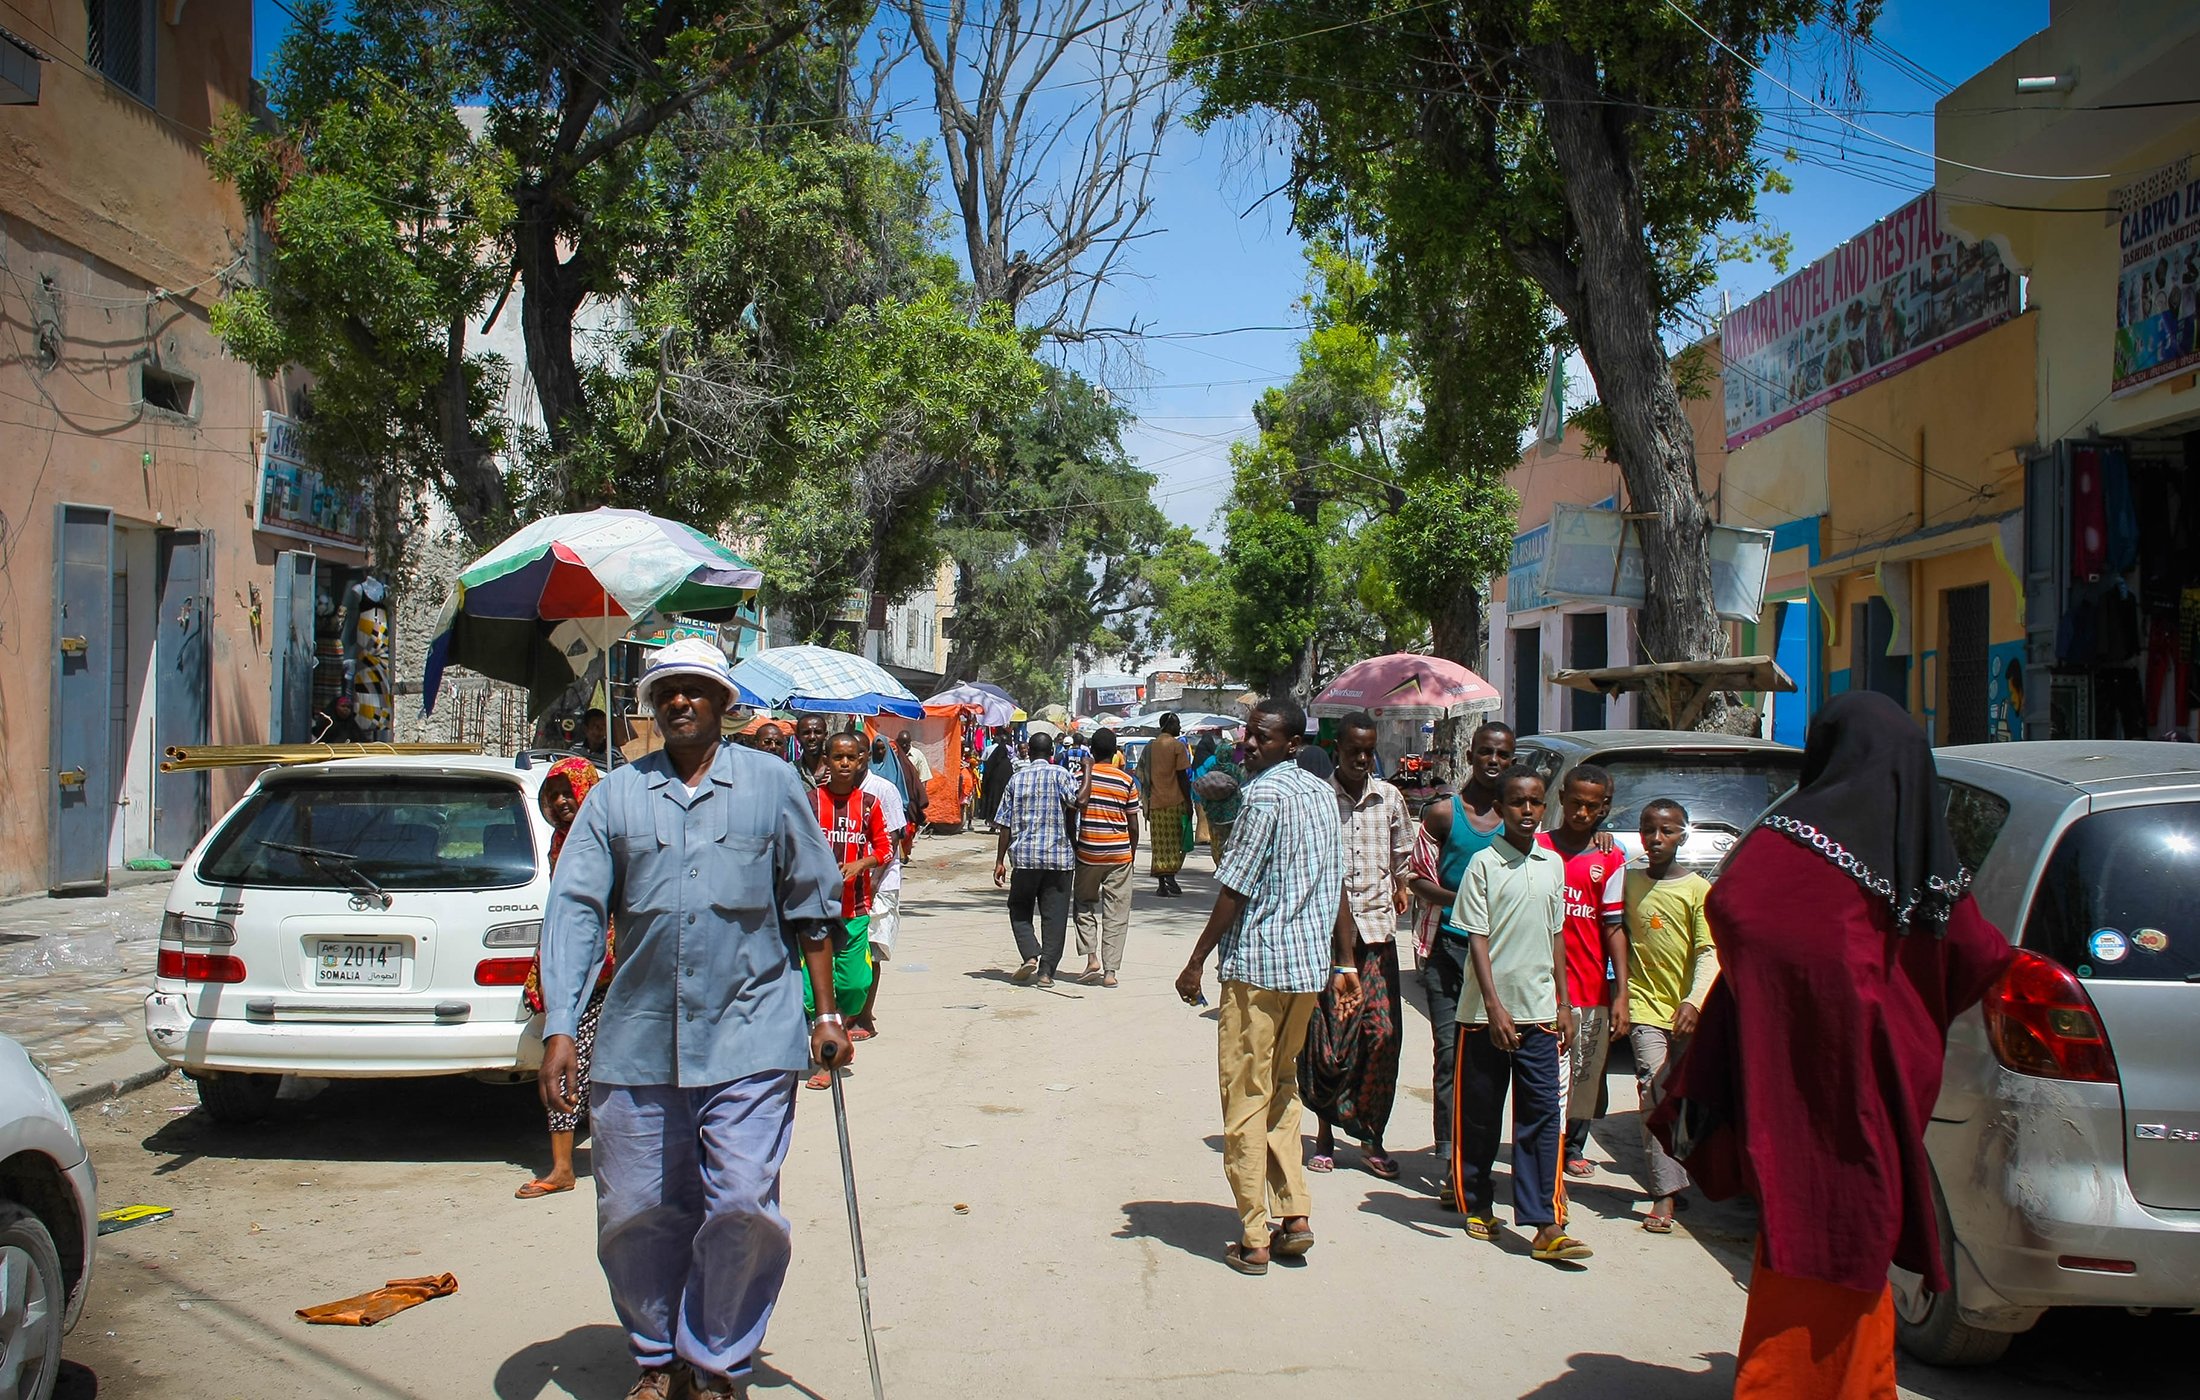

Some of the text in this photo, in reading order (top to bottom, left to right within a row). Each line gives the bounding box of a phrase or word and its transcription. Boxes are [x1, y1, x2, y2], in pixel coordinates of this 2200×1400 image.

[2120, 190, 2180, 249] CARWO
[1723, 191, 1947, 364] ANKARA HOTEL AND RESTAU
[1328, 687, 1364, 698] Sportsman
[838, 816, 857, 831] Fly
[488, 904, 540, 912] COROLLA
[344, 945, 387, 967] 2014
